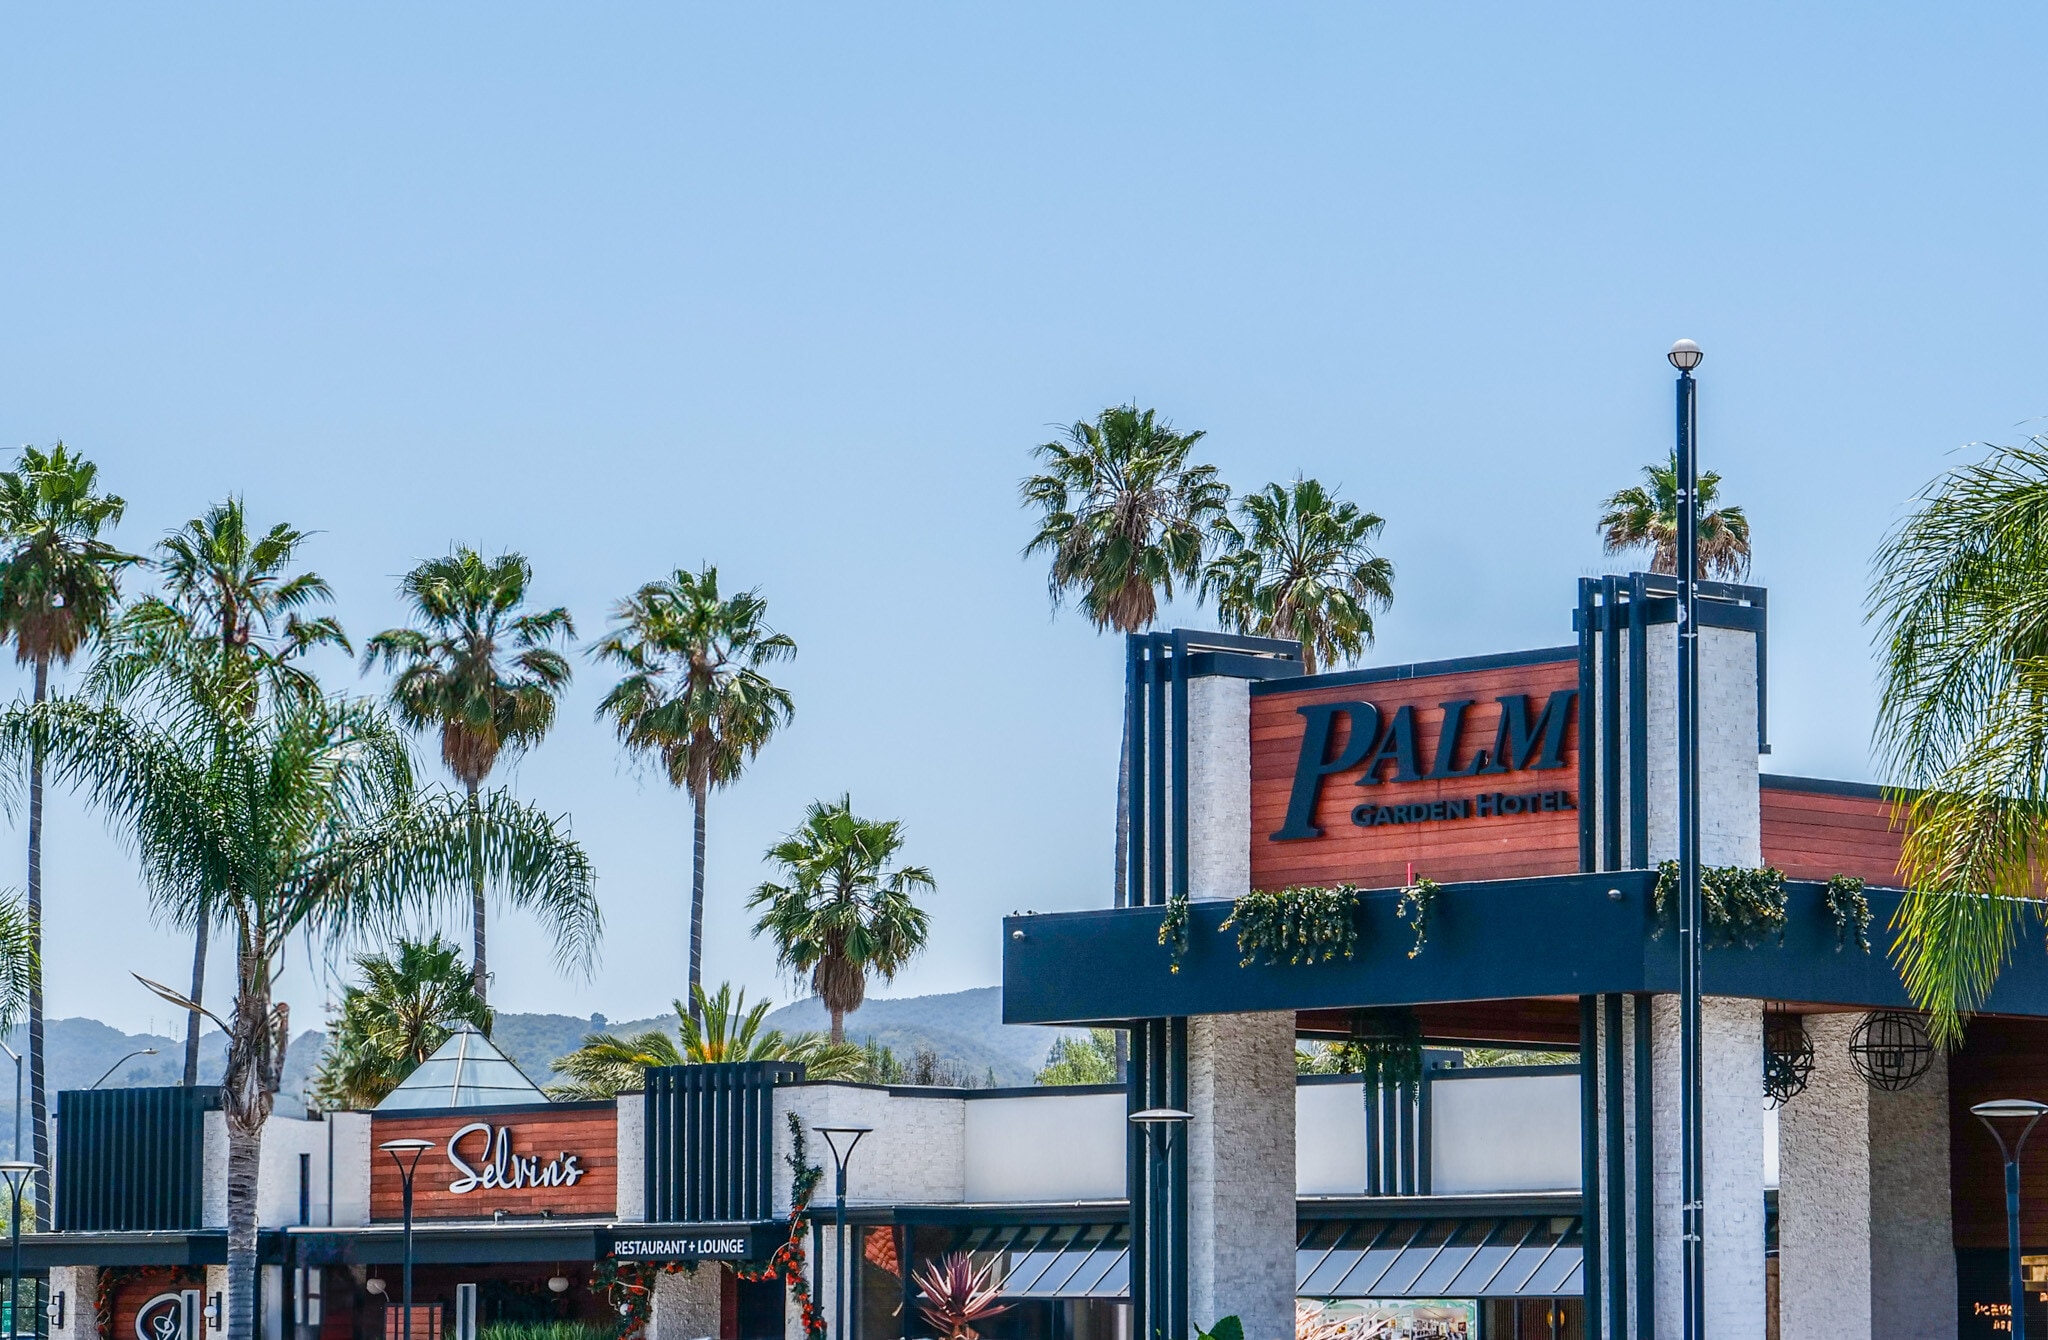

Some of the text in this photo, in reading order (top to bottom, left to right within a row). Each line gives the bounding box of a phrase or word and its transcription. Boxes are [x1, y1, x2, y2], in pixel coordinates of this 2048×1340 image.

[1269, 689, 1578, 841] PALM
[1351, 791, 1577, 828] GARDEN HOTEL
[447, 1122, 584, 1194] Selvin's
[614, 1239, 744, 1255] RESTAURANT + LOUNGE
